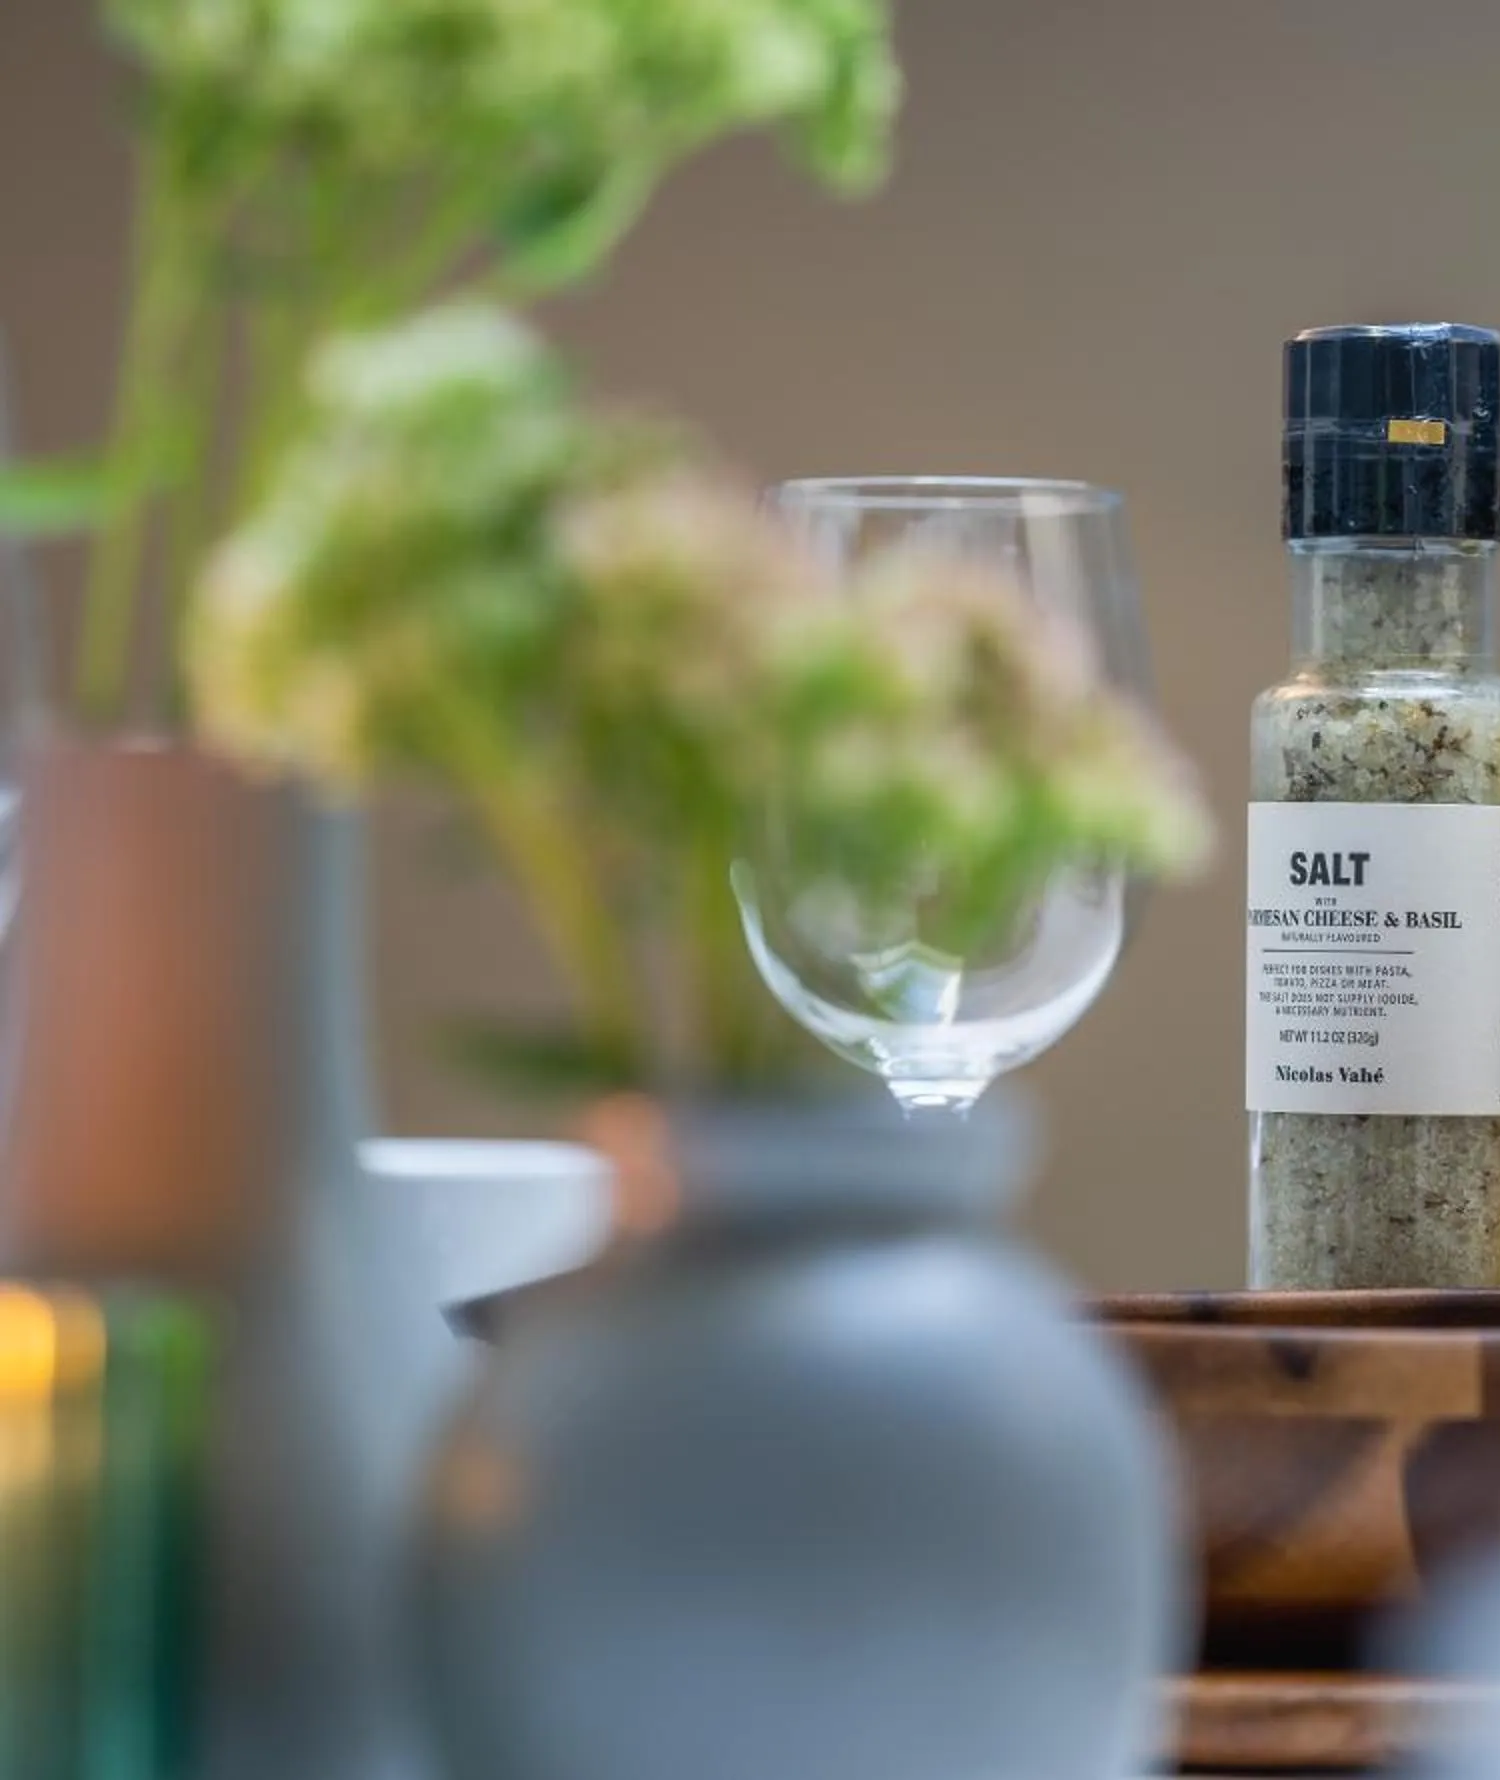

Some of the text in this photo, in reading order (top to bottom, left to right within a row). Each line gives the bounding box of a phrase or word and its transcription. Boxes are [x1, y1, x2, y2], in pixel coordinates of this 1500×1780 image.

[1290, 851, 1370, 887] SALT
[1314, 896, 1337, 907] WITH
[1249, 908, 1463, 929] MESAN CHEESE & BASIL
[1281, 931, 1381, 943] NATURALLY FLAVOURED
[1310, 964, 1343, 976] DISHES
[1345, 965, 1372, 976] WITH
[1375, 965, 1413, 978] PASTA,
[1310, 977, 1337, 989] PIZZA
[1315, 993, 1335, 1003] NOT
[1336, 993, 1375, 1005] SUPPLY
[1282, 1005, 1329, 1017] NECESSARY
[1330, 1030, 1345, 1044] OZ
[1275, 1064, 1384, 1083] Nicolas Vahé
